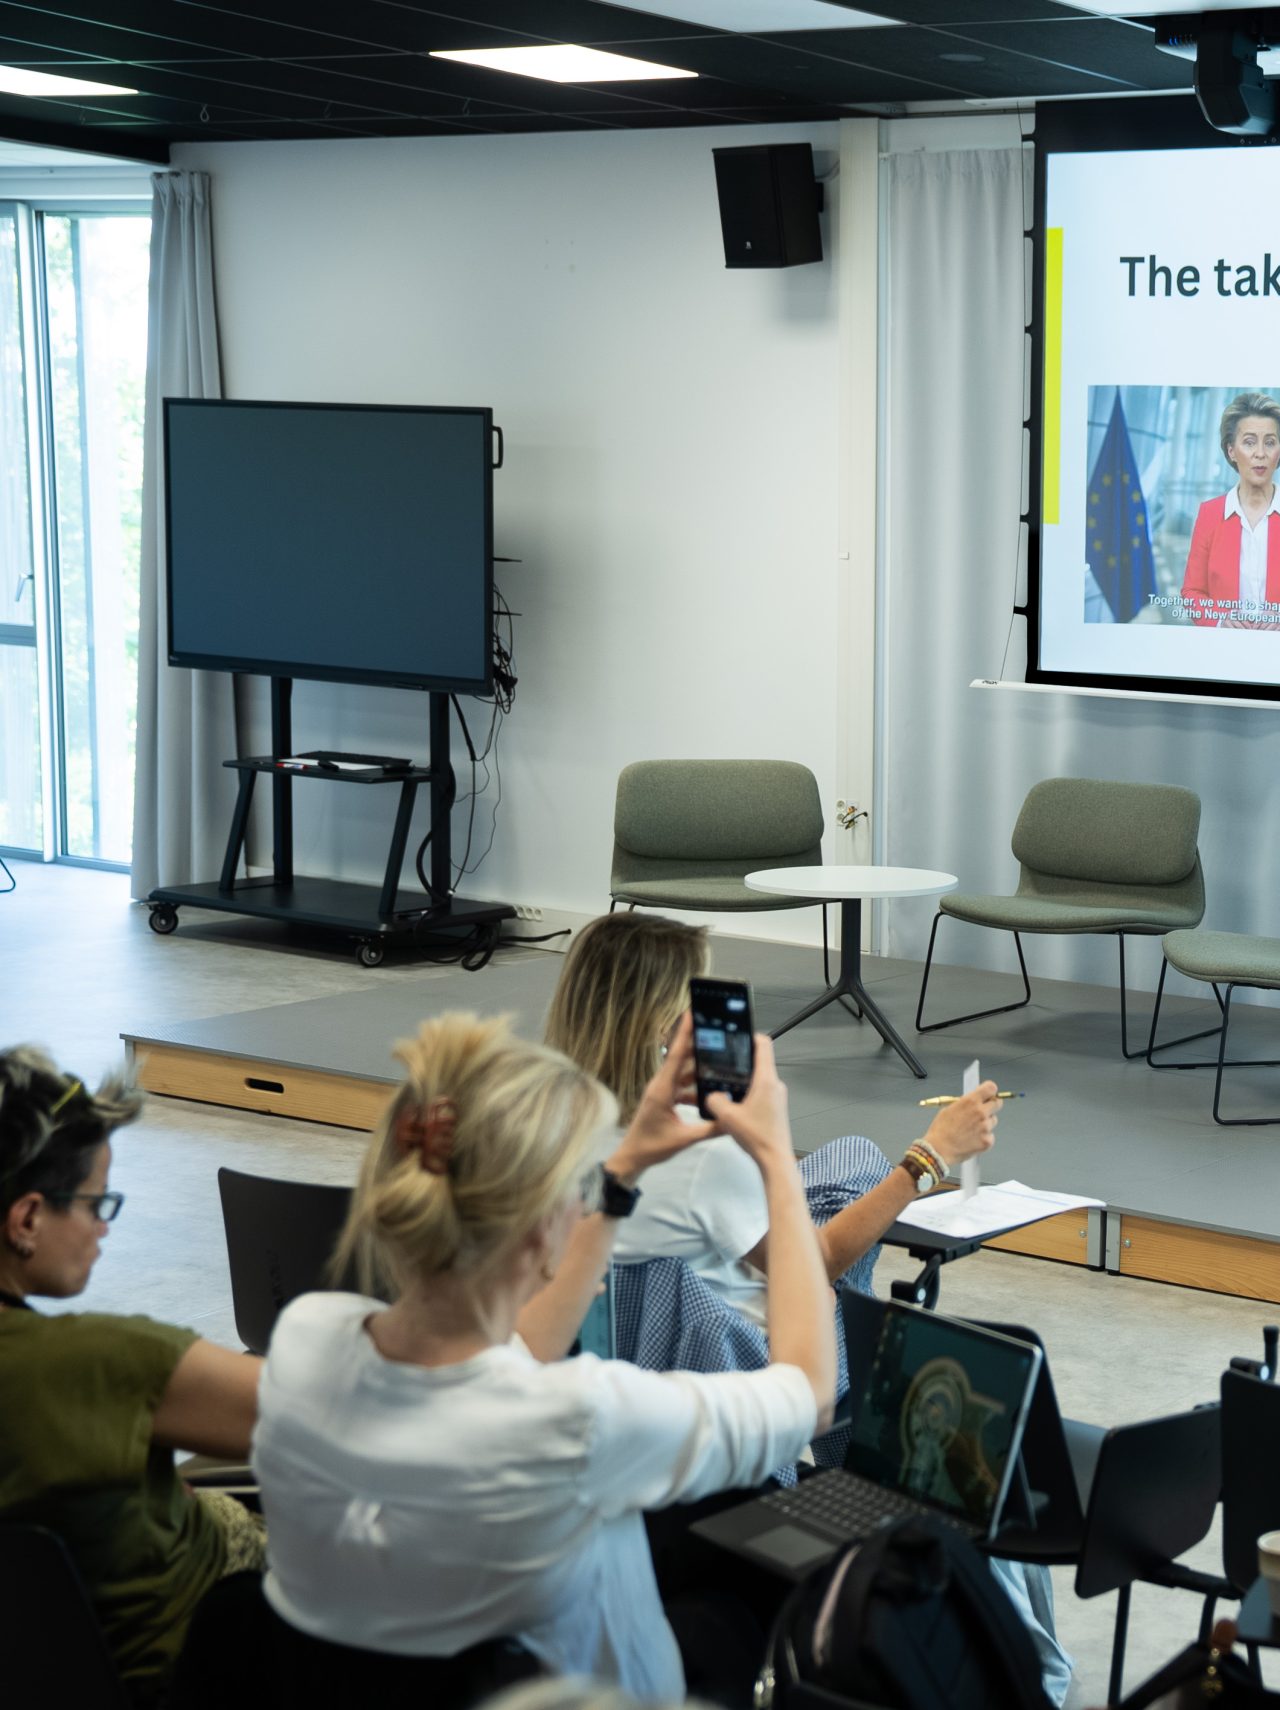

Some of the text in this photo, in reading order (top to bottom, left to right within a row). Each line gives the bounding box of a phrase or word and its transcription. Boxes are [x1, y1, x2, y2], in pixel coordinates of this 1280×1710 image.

[1119, 254, 1201, 297] The
[1148, 594, 1197, 608] Together,
[1199, 599, 1214, 608] we
[1217, 600, 1242, 609] want
[1245, 600, 1257, 610] to
[1171, 607, 1185, 617] of
[1185, 608, 1202, 619] the
[1204, 609, 1226, 620] New
